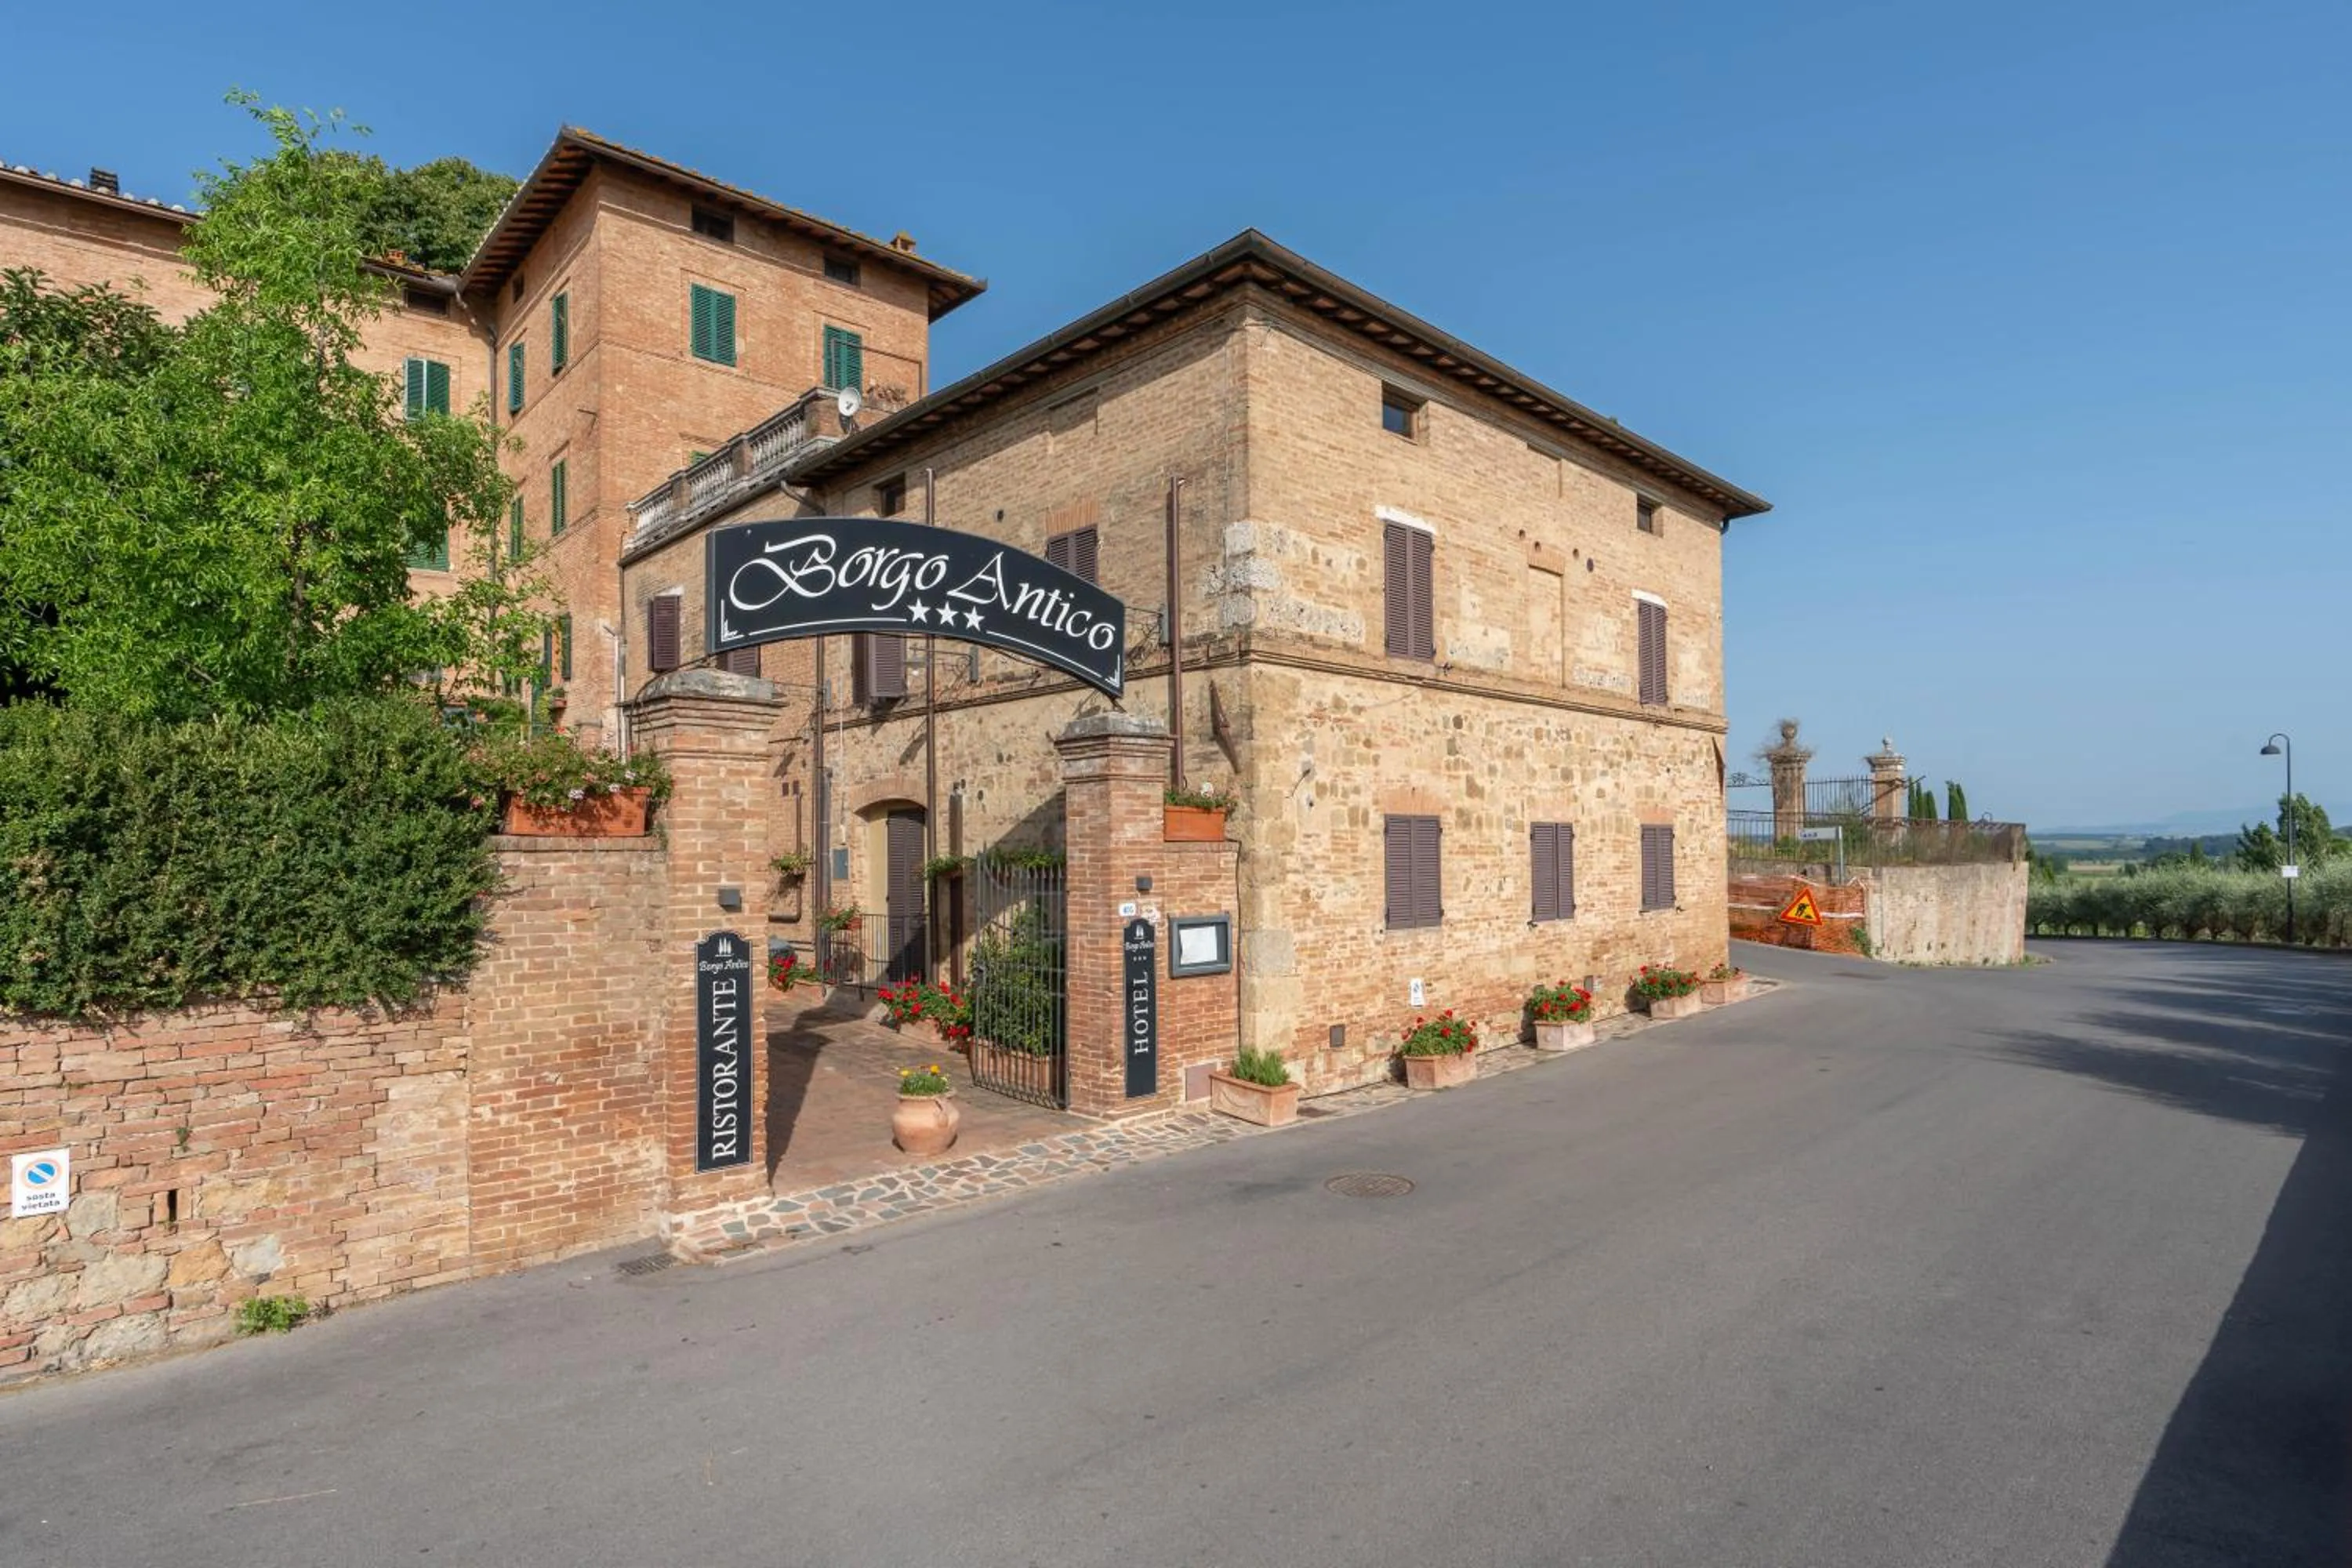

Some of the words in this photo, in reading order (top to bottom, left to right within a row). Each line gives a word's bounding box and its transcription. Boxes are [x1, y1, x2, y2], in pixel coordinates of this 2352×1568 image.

[729, 534, 947, 611] Borgo
[947, 552, 1115, 650] Antico
[1134, 972, 1149, 1054] HOTEL
[713, 979, 737, 1159] RISTORANTE
[21, 1200, 60, 1210] vietata
[26, 1192, 56, 1200] sosta
